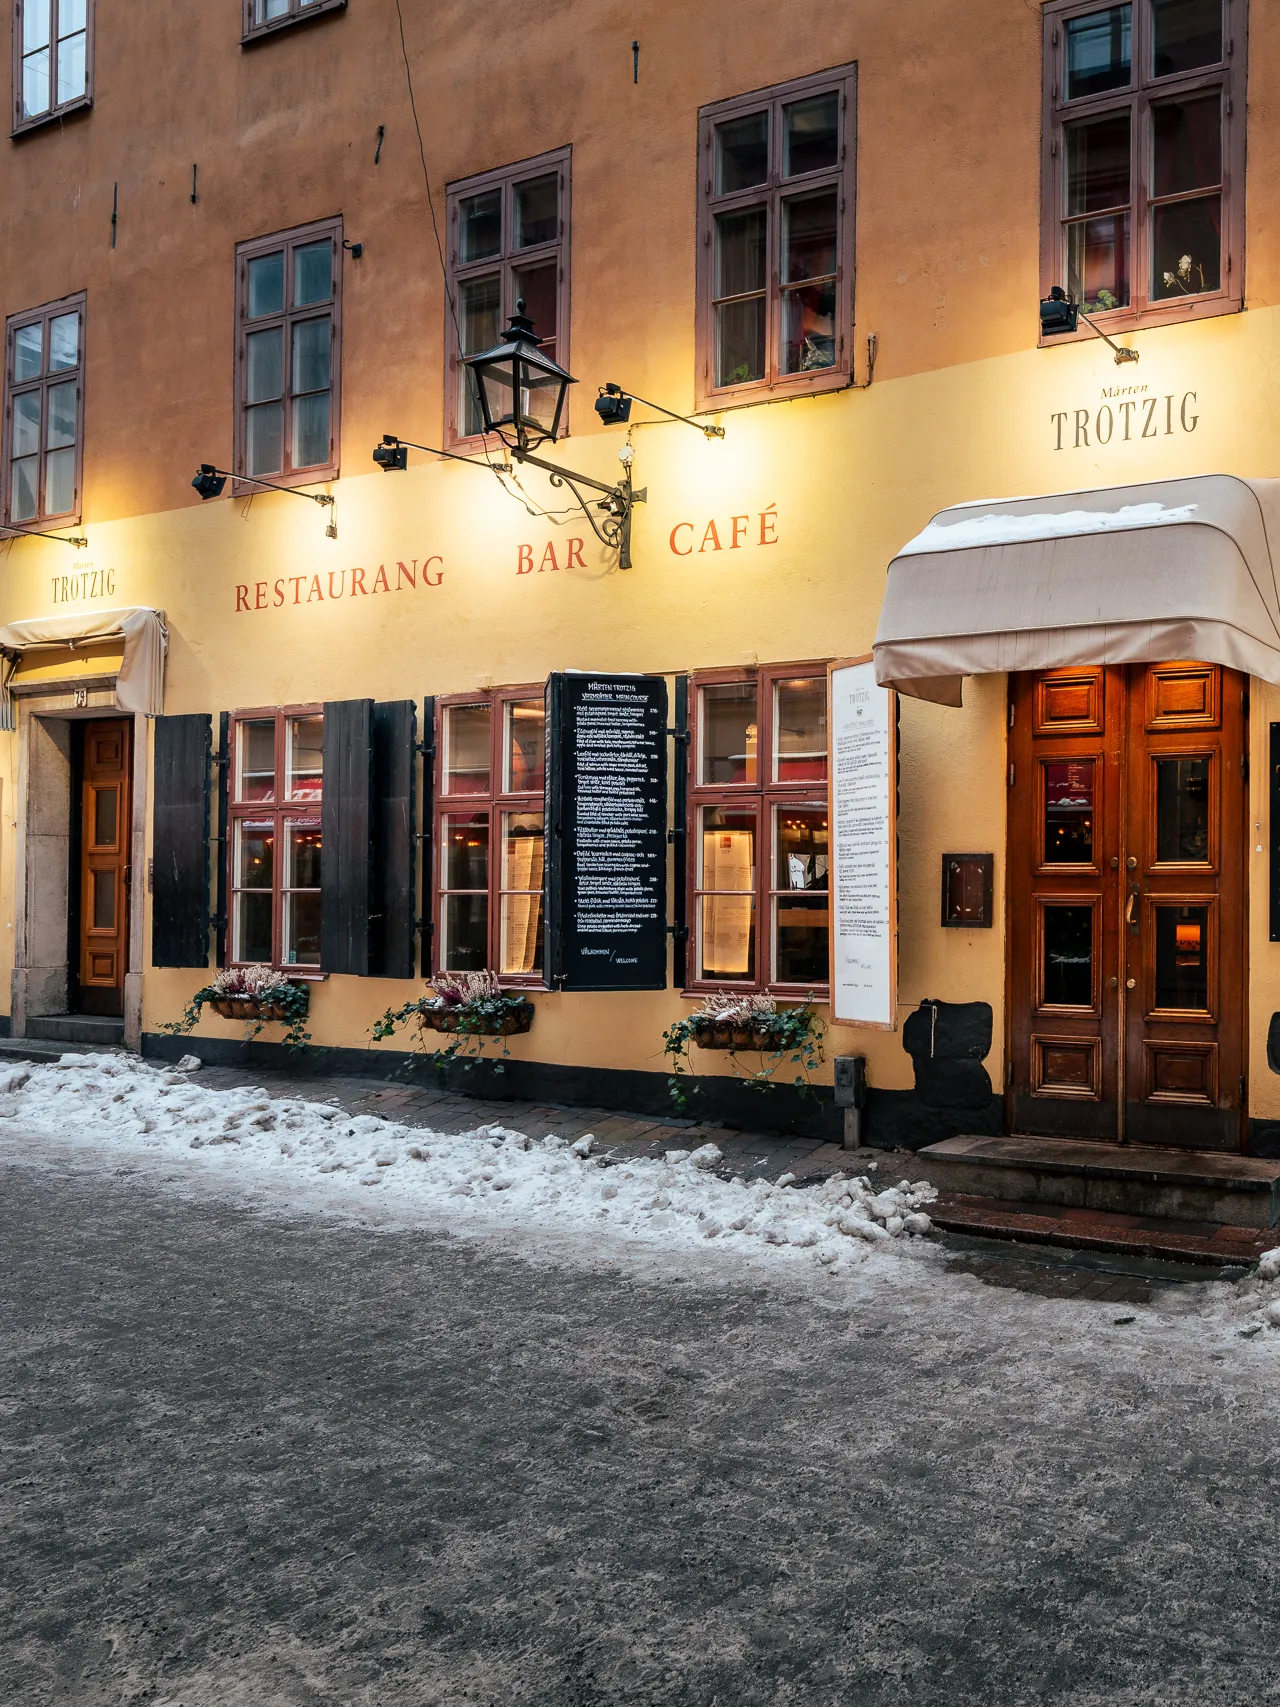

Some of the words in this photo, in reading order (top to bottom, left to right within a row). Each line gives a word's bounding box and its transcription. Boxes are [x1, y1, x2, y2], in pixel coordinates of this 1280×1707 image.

[1101, 384, 1149, 400] Mårten
[1050, 392, 1200, 450] TROTZIG
[234, 555, 445, 613] RESTAURANG
[515, 537, 588, 576] BAR
[669, 503, 780, 556] CAFÉ
[52, 569, 116, 603] TROTZIG
[613, 684, 636, 692] TROTZIG
[76, 690, 85, 703] 79
[581, 947, 610, 955] VÄLKOMMEN
